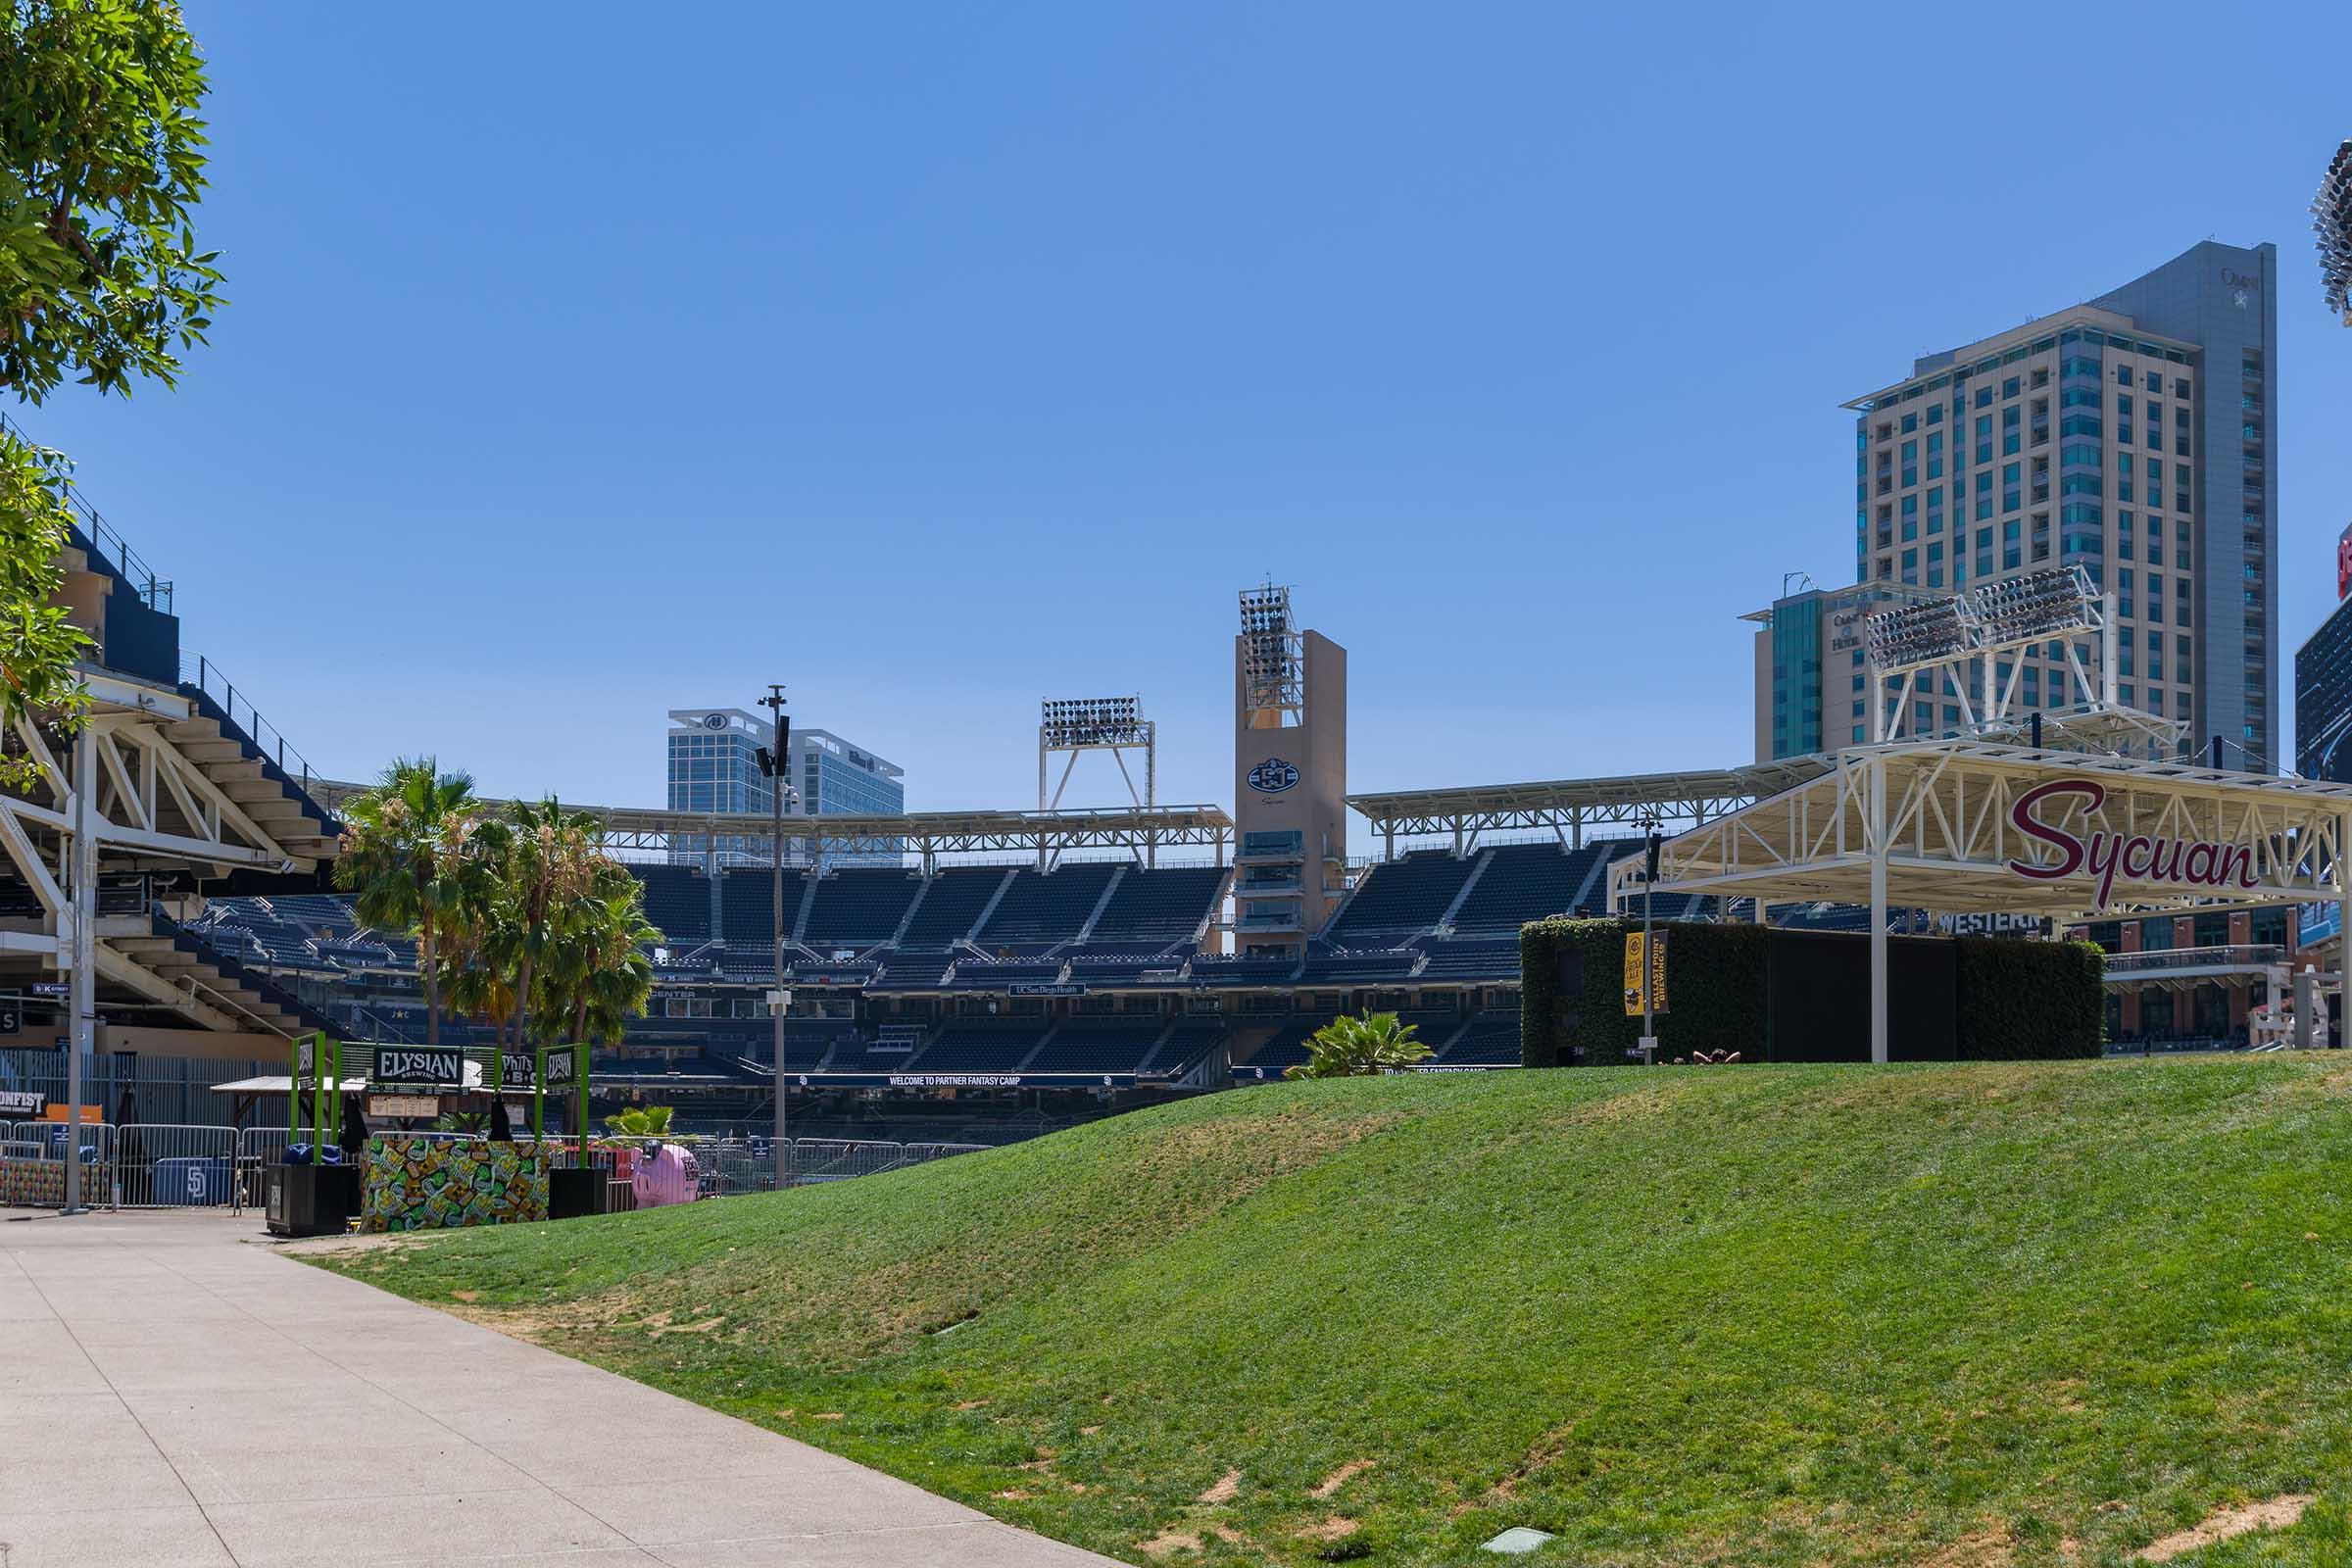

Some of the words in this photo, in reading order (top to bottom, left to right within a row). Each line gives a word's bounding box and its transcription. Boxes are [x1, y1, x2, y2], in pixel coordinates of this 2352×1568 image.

[2003, 778, 2261, 912] Sycuan
[380, 1052, 458, 1078] ELYSIAN
[402, 1071, 436, 1080] BREWING
